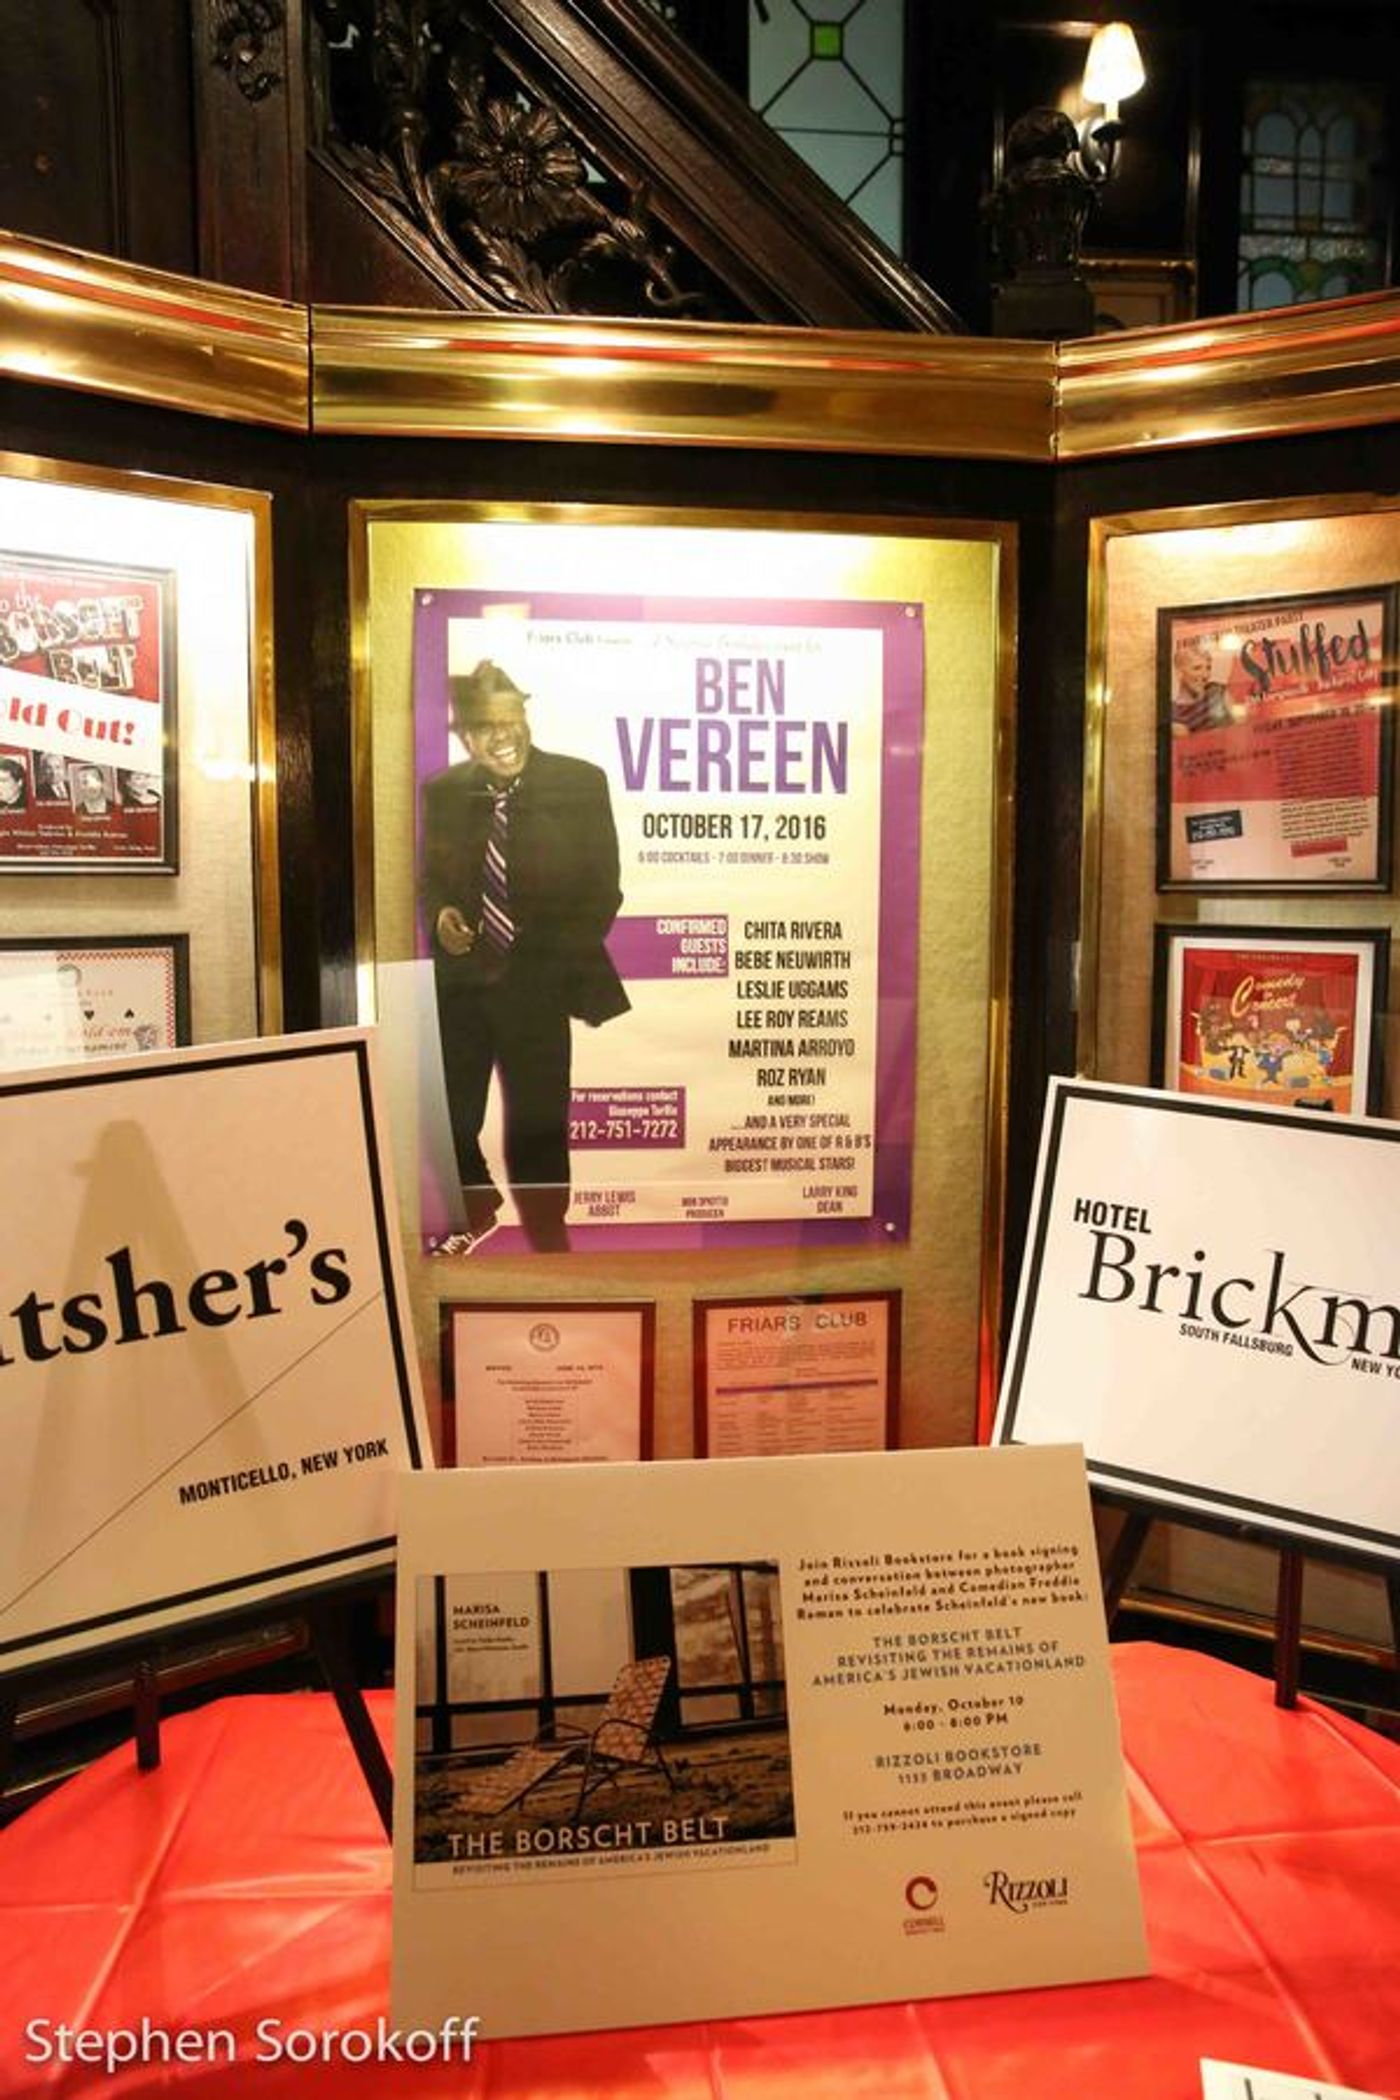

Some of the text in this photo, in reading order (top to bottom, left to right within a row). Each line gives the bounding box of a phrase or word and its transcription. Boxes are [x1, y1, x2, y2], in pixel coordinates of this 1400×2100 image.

[1241, 618, 1370, 700] Stuffed
[695, 657, 785, 716] BEN
[616, 716, 849, 796] VEREEN
[642, 813, 827, 842] OCTOBER 17, 2016
[655, 918, 727, 936] CONFIRMED
[743, 920, 843, 940] CHITA RIVERA
[680, 937, 727, 955] GUESTS
[734, 949, 851, 970] BEBE NEUWIRTH
[736, 979, 848, 1000] LESLIE UGGAMS
[736, 1009, 849, 1029] LEE ROY REAMS
[728, 1038, 855, 1058] MARTINA ARROYO
[757, 1067, 827, 1087] ROZ RYAN
[767, 1094, 787, 1106] AND
[570, 1119, 678, 1140] 212-751-7272
[769, 1115, 777, 1128] A
[779, 1115, 806, 1128] VERY
[808, 1113, 850, 1127] SPECIAL
[709, 1136, 777, 1151] APPEARANCE
[779, 1136, 794, 1149] BY
[796, 1136, 817, 1149] ONE
[818, 1136, 832, 1149] OF
[724, 1158, 768, 1173] BIGGEST
[771, 1157, 817, 1172] MUSICAL
[603, 1190, 636, 1204] LEWIS
[802, 1184, 858, 1199] LARRY KING
[816, 1201, 843, 1214] DEAN
[1073, 1197, 1152, 1234] HOTEL
[0, 1218, 352, 1367] tsher's
[727, 1311, 868, 1334] FRIARS CLUB
[1180, 1322, 1293, 1358] SOUTH FALLSBURG
[1351, 1357, 1382, 1375] NEW
[179, 1437, 389, 1505] MONTICELLO, NEW YORK
[799, 1558, 828, 1571] Join
[884, 1551, 953, 1566] Bookstore
[958, 1549, 978, 1561] for
[994, 1546, 1025, 1559] book
[1030, 1544, 1079, 1558] signing
[804, 1561, 1075, 1587] and conversation between photographer
[802, 1575, 1080, 1603] Marisa Scheinfeld and Comedian Freddie
[452, 1604, 500, 1615] MARISA
[796, 1606, 843, 1621] Roman
[848, 1606, 862, 1617] to
[867, 1601, 931, 1617] celebrate
[1022, 1595, 1048, 1606] new
[452, 1616, 530, 1630] SCHEINFELD
[873, 1626, 1023, 1649] THE BORSCHT BELT
[837, 1640, 1059, 1668] REVISITING THE REMAINS OF
[812, 1655, 1086, 1686] AMERICA'S JEWISH VACATIONLAND
[883, 1695, 1024, 1717] Monday, October 10
[986, 1712, 1008, 1726] PM
[875, 1743, 1043, 1769] RIZZOLI BOOKSTORE
[932, 1762, 1023, 1783] BROADWAY
[843, 1791, 1083, 1822] If you cannot attend this event please call
[931, 1817, 944, 1828] to
[946, 1814, 998, 1829] purchase
[1010, 1809, 1048, 1823] signed
[1050, 1808, 1076, 1820] copy
[447, 1815, 729, 1858] THE BORSCHT BELT
[452, 1863, 511, 1875] REVISITING
[534, 1857, 580, 1869] REMAINS
